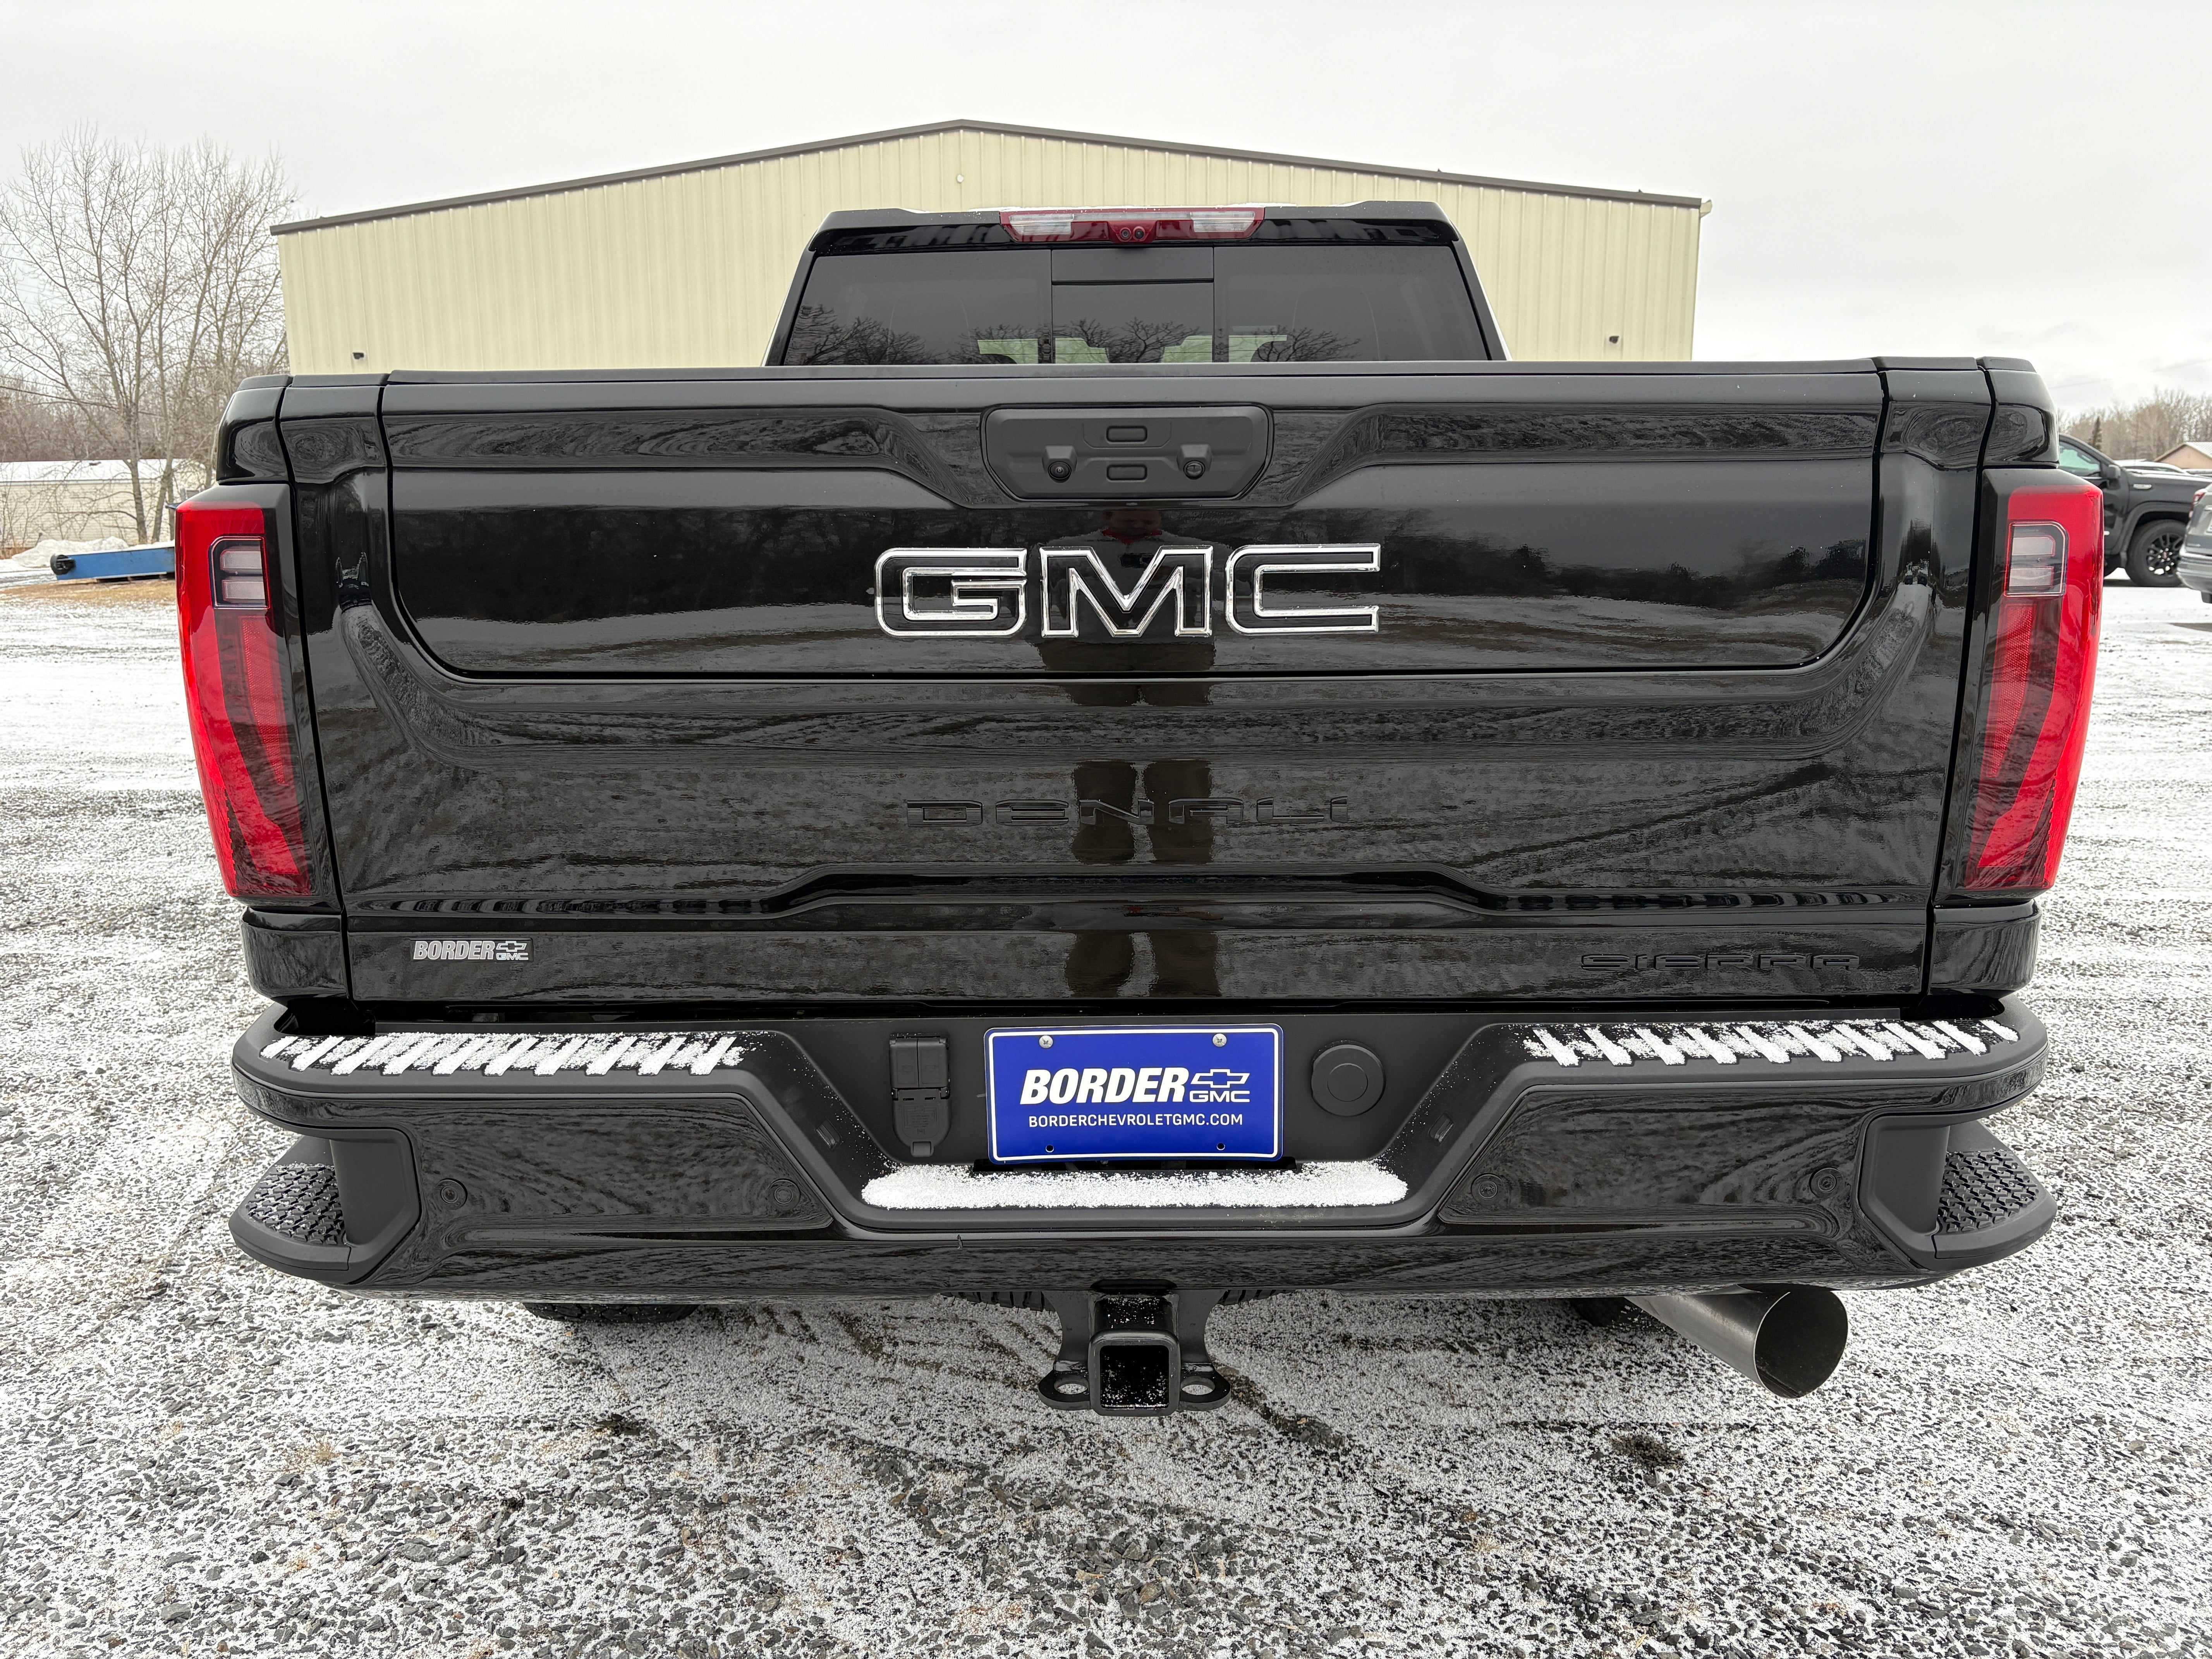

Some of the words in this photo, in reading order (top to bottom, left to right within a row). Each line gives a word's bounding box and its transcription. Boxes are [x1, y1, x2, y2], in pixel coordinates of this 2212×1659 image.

[874, 544, 1381, 638] GMC
[907, 796, 1348, 828] DENALI
[413, 941, 495, 960] BORDER
[1581, 953, 1860, 971] SIERRA
[1020, 1067, 1189, 1104] BORDER
[1189, 1090, 1250, 1103] GMC
[1029, 1113, 1243, 1128] BORDERCHEVROLETGMC.COM
